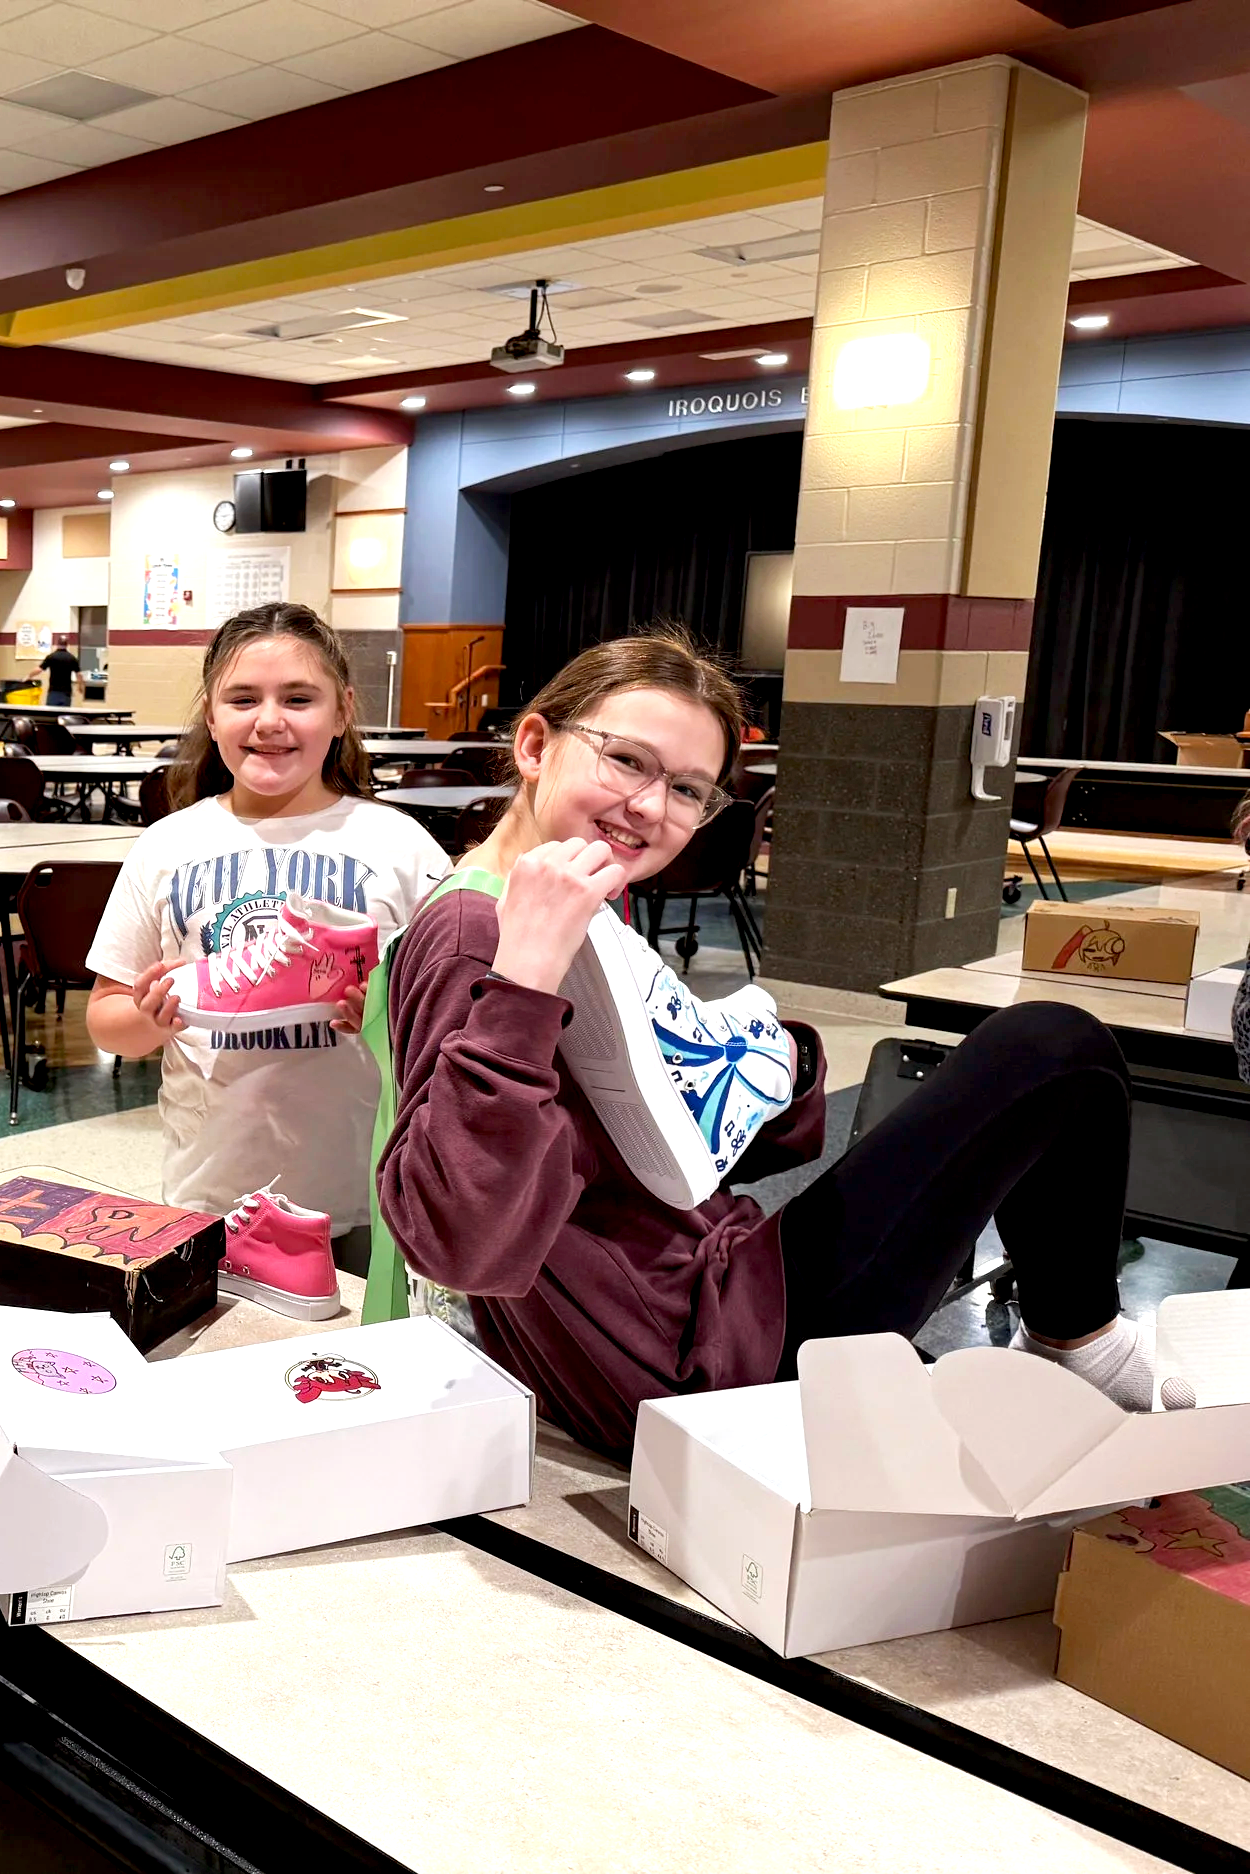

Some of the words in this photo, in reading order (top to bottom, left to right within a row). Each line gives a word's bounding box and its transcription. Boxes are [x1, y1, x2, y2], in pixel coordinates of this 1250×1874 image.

[668, 389, 783, 417] IROQUOIS
[165, 849, 253, 940] NEW
[261, 848, 378, 914] YORK
